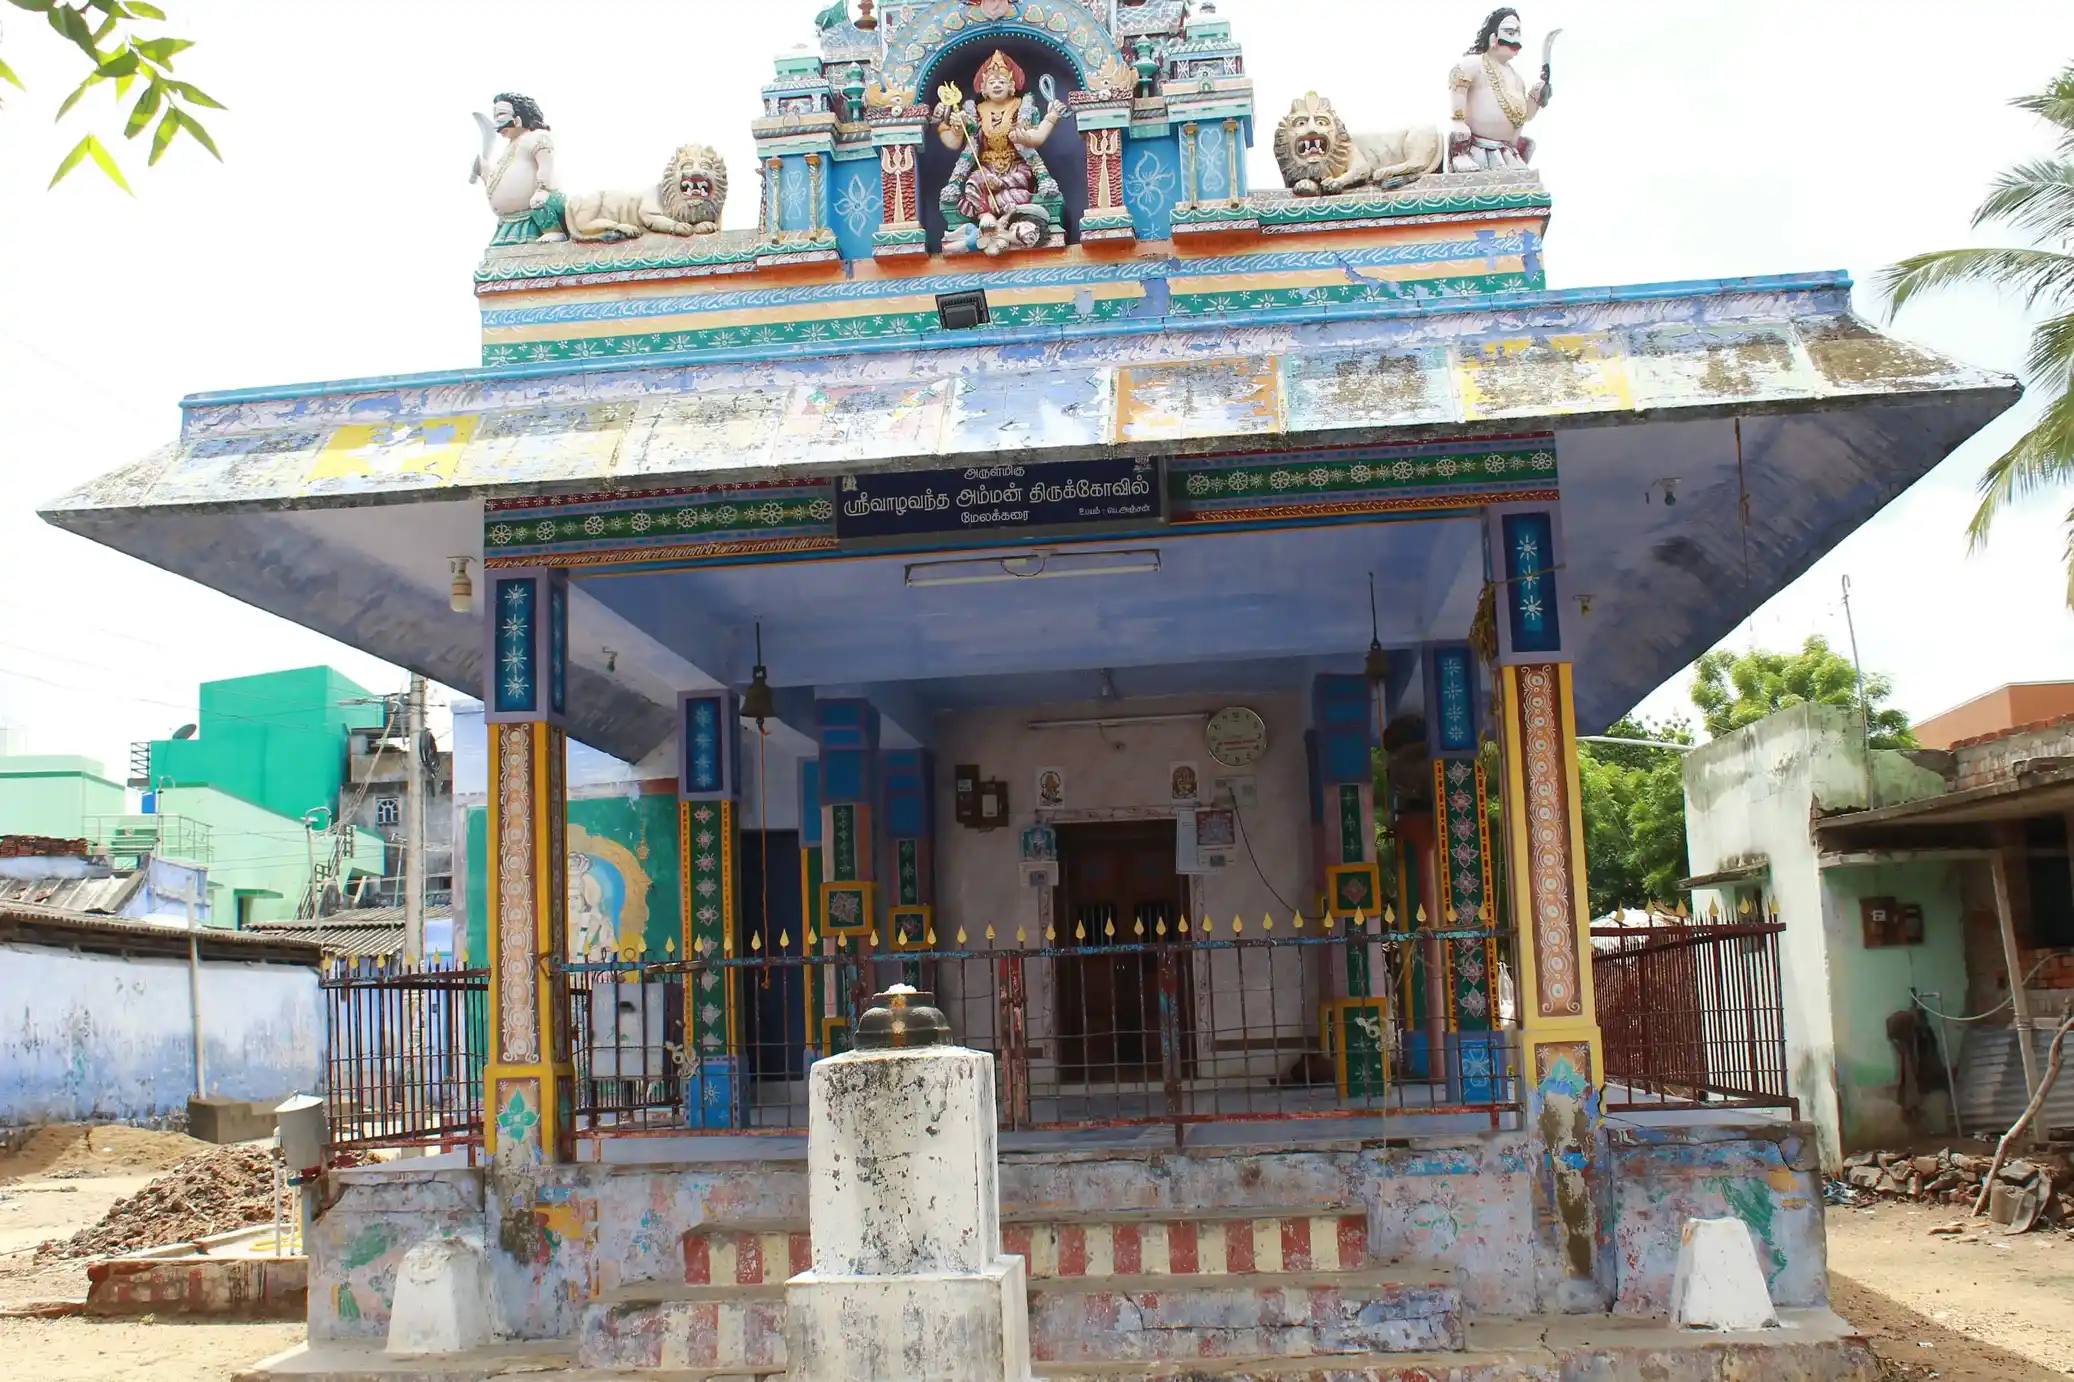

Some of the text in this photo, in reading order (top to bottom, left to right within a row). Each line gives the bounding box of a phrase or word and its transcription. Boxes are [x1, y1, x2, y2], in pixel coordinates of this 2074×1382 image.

[964, 464, 1025, 480] அருள்மிகு
[956, 482, 1023, 508] அம்மன்
[1029, 474, 1150, 503] திருக்கோவில்
[960, 508, 1030, 524] மேலக்கரை
